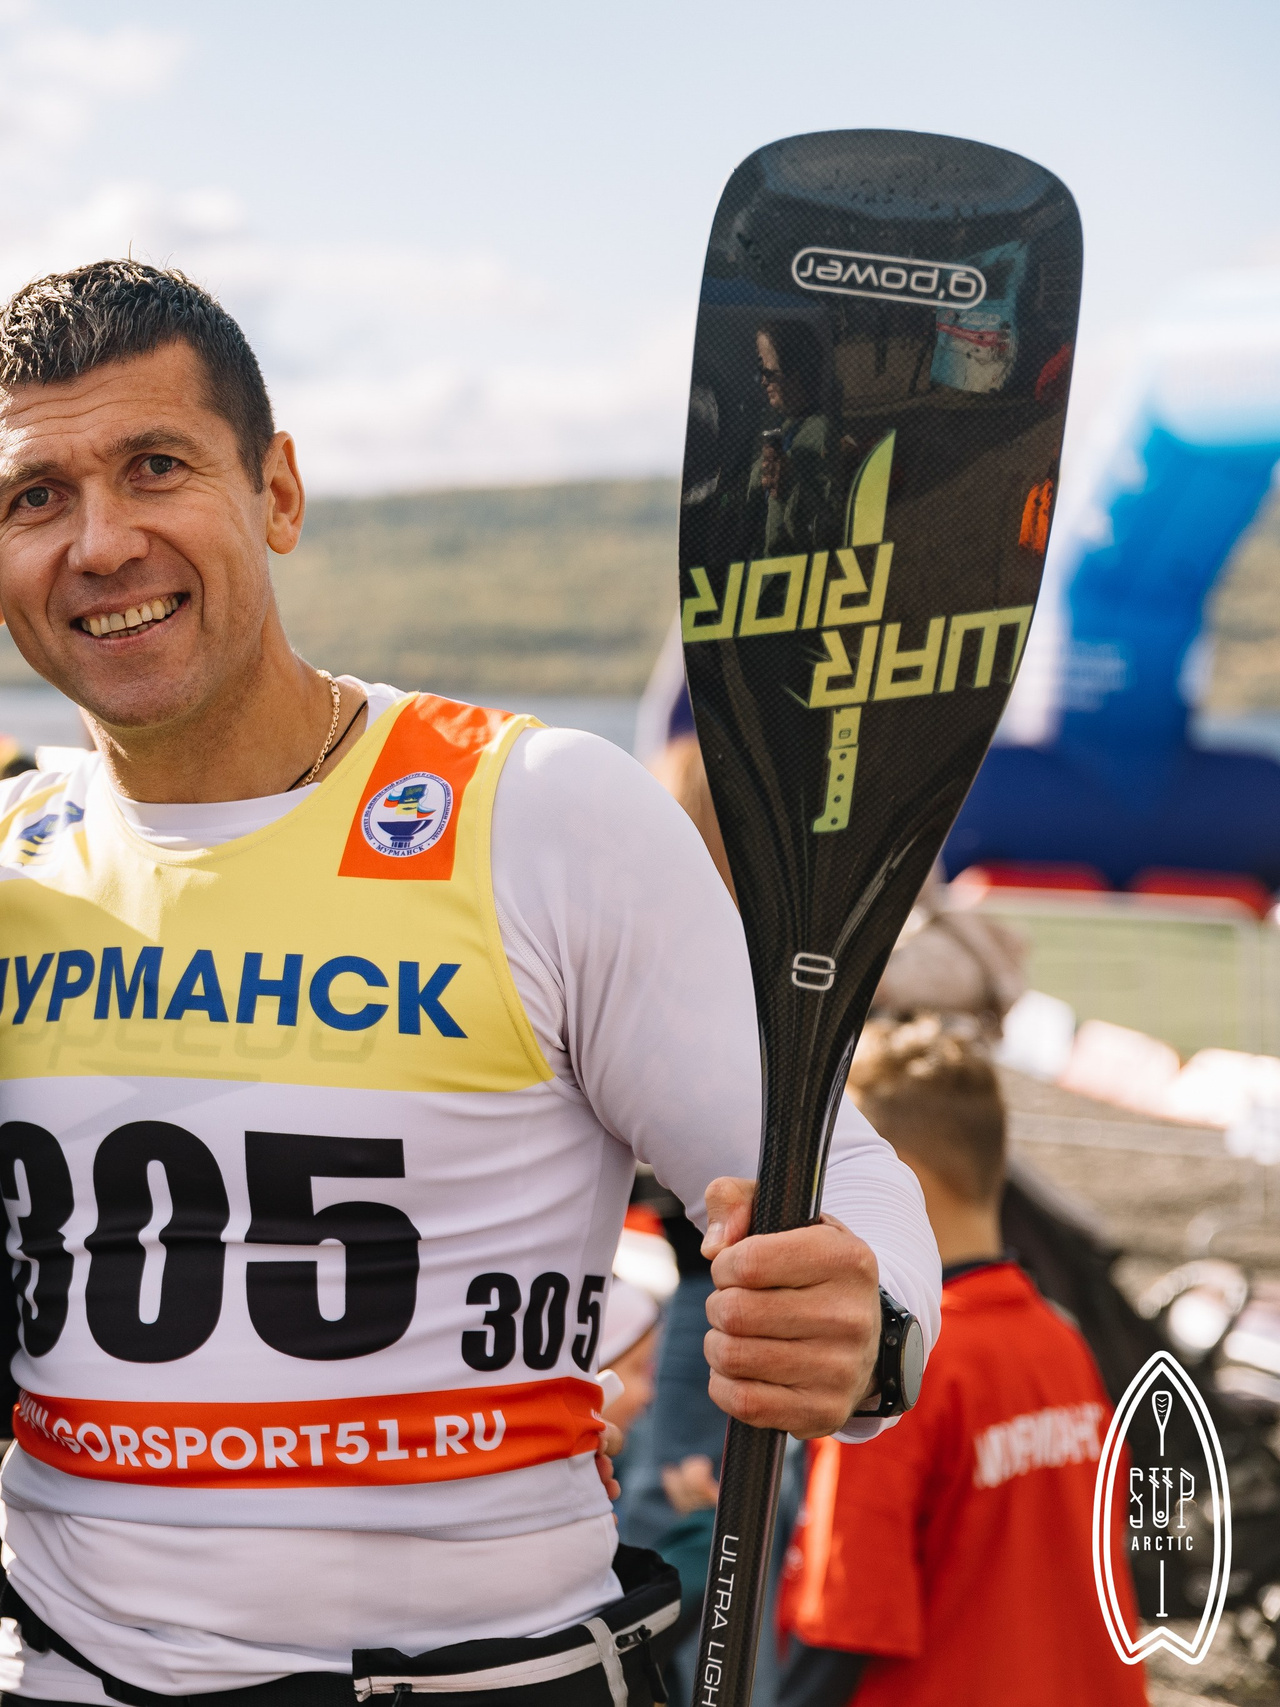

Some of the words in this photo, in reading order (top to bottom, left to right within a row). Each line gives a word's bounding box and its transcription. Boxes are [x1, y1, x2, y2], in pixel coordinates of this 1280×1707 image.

[799, 256, 977, 299] g'power
[682, 541, 895, 643] RIOR
[808, 604, 1035, 709] WAR
[375, 846, 425, 857] МУРМАНСК
[461, 1271, 607, 1374] 305
[711, 1534, 740, 1630] ULTRA
